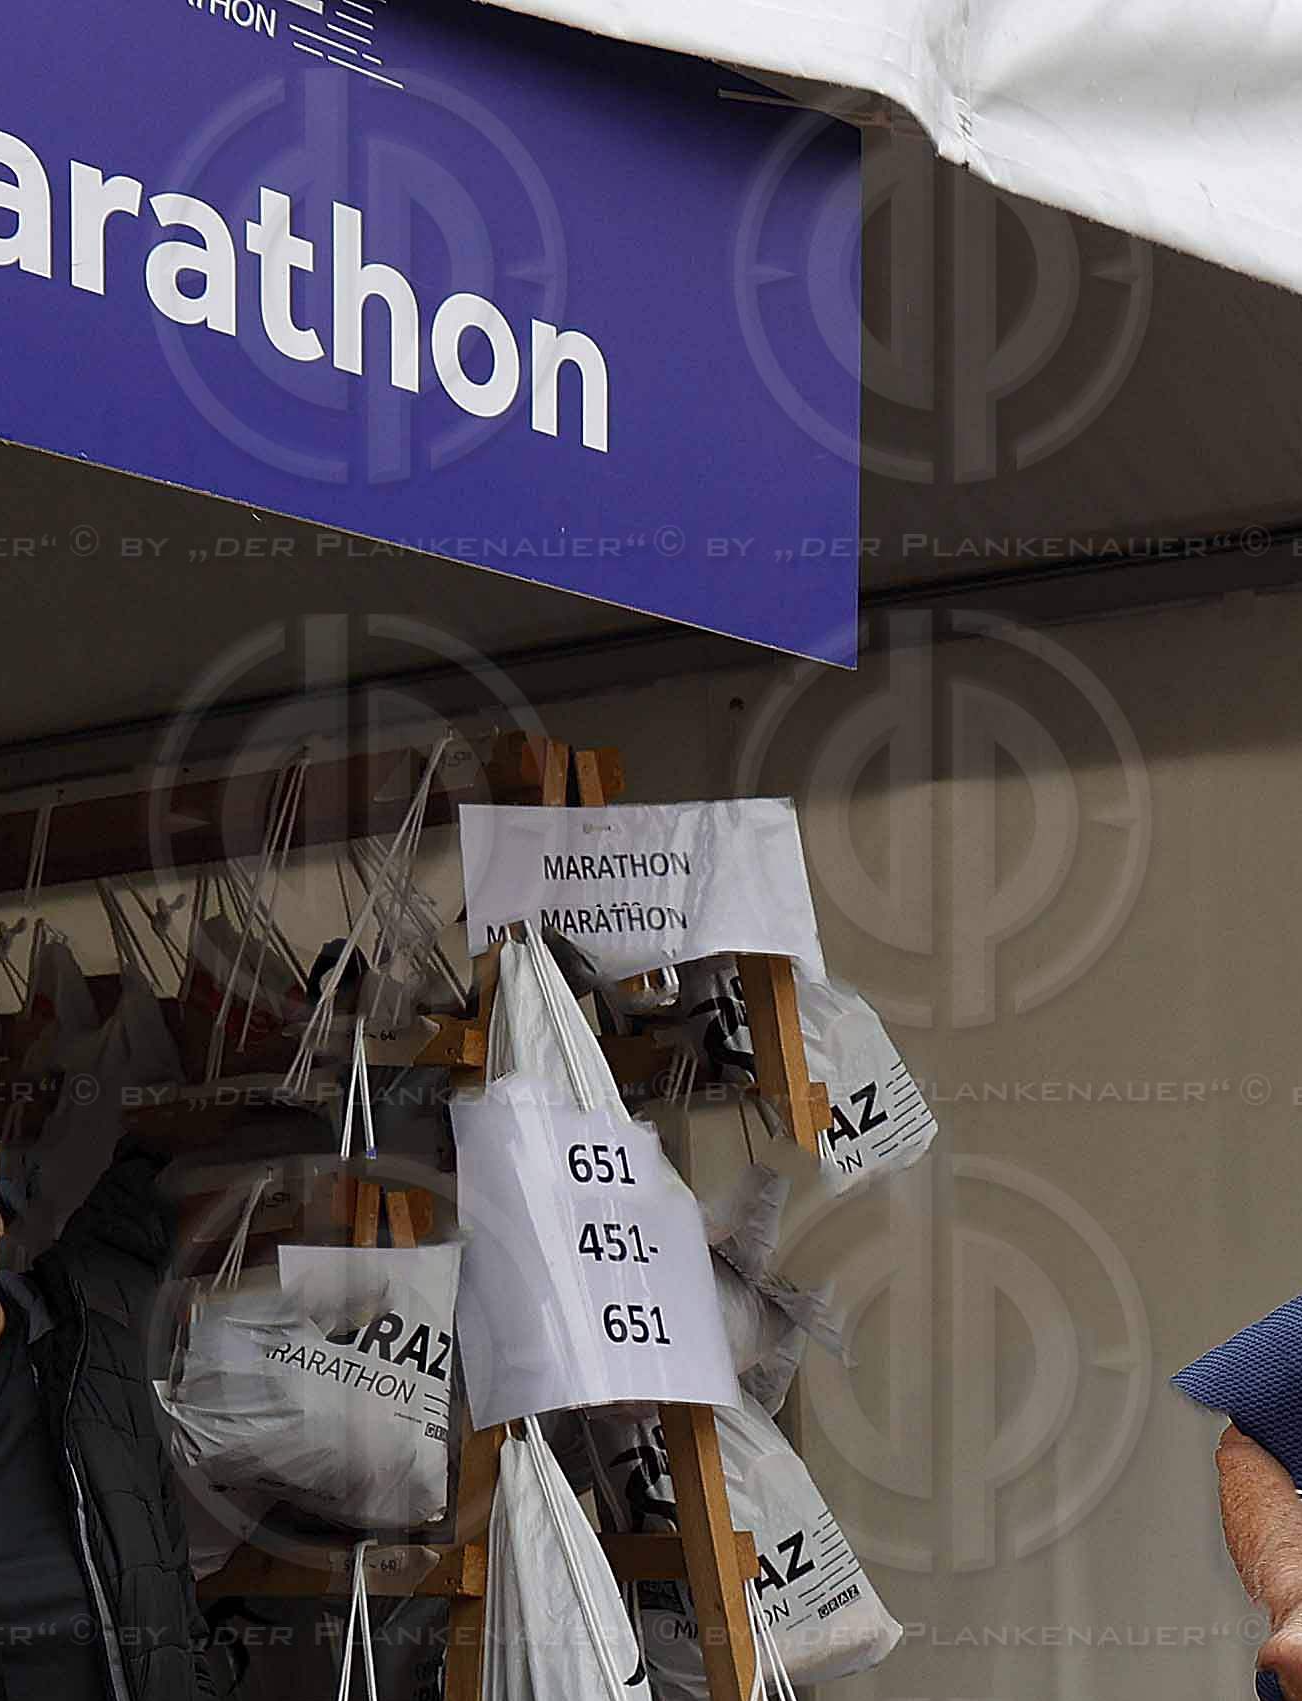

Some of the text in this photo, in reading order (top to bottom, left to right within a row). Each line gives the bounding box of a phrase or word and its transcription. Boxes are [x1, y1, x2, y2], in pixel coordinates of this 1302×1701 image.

[543, 852, 691, 881] MARATHON
[567, 1143, 636, 1185] 651
[578, 1222, 659, 1264] 451-
[602, 1303, 671, 1346] 651
